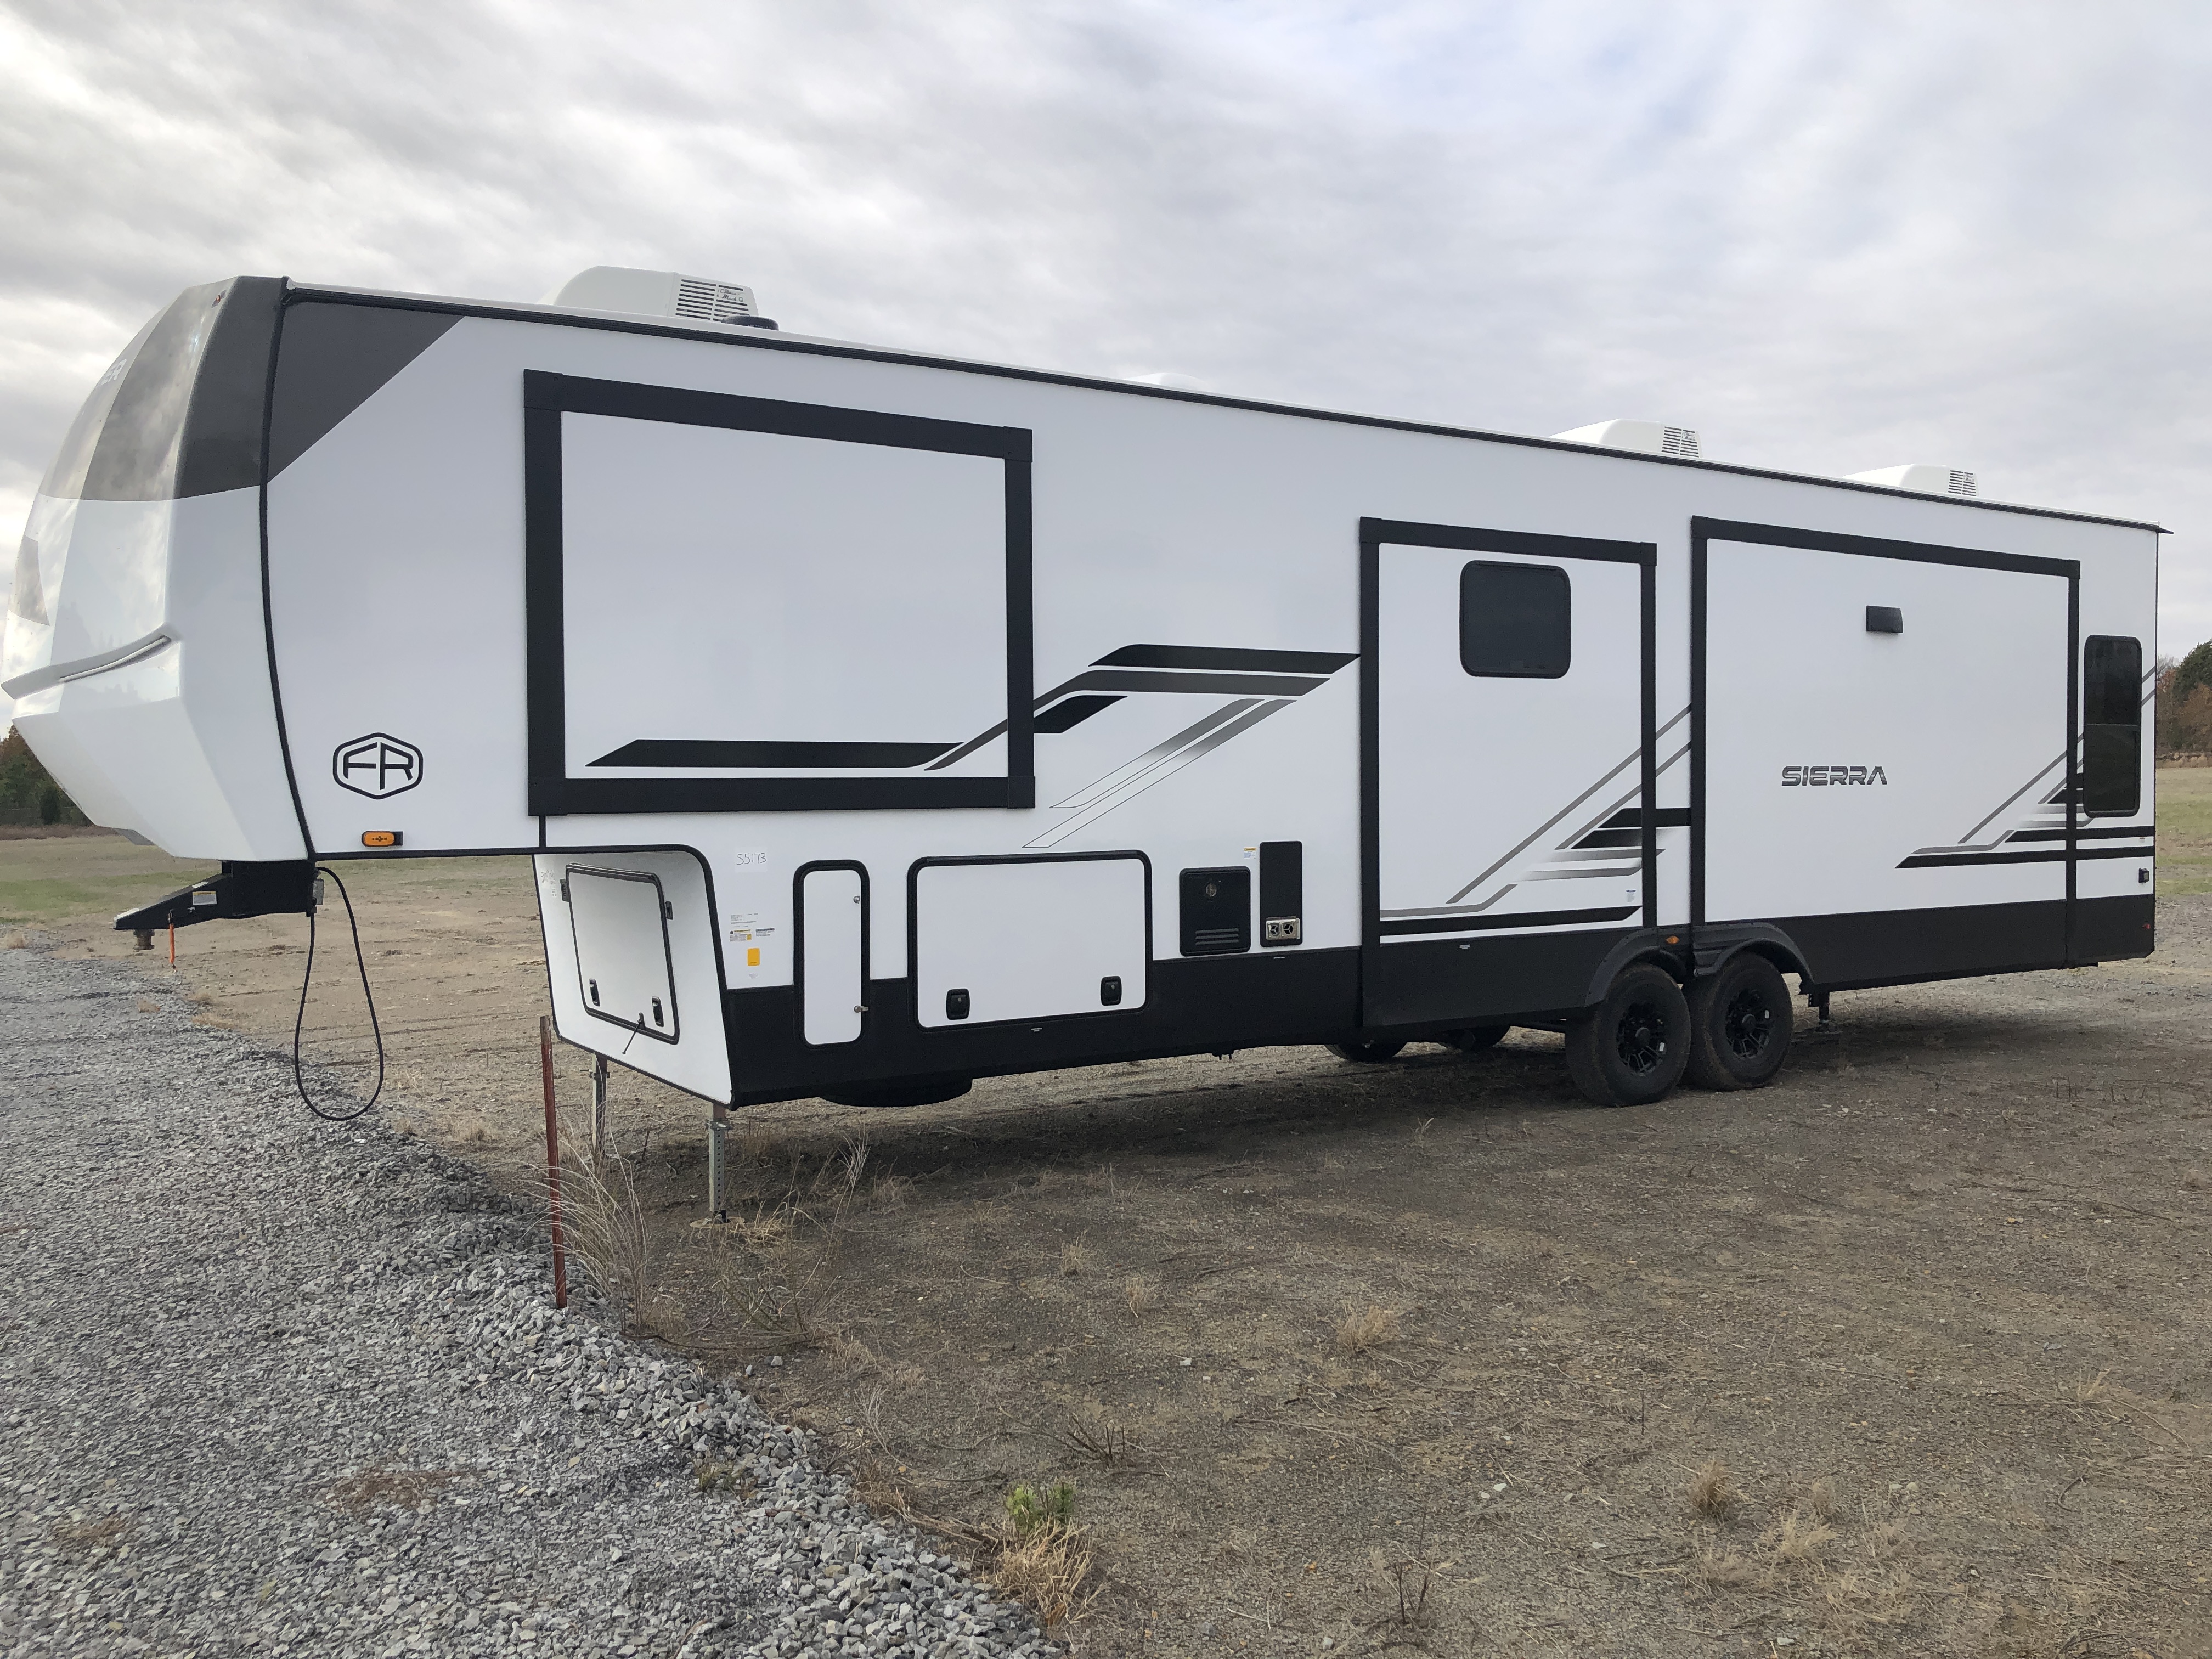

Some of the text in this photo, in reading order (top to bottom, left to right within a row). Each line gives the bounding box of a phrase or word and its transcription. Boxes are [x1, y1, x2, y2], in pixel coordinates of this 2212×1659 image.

[98, 358, 128, 386] ER
[343, 742, 414, 791] FR
[1781, 765, 1888, 786] SIERRA
[736, 853, 767, 865] 55173
